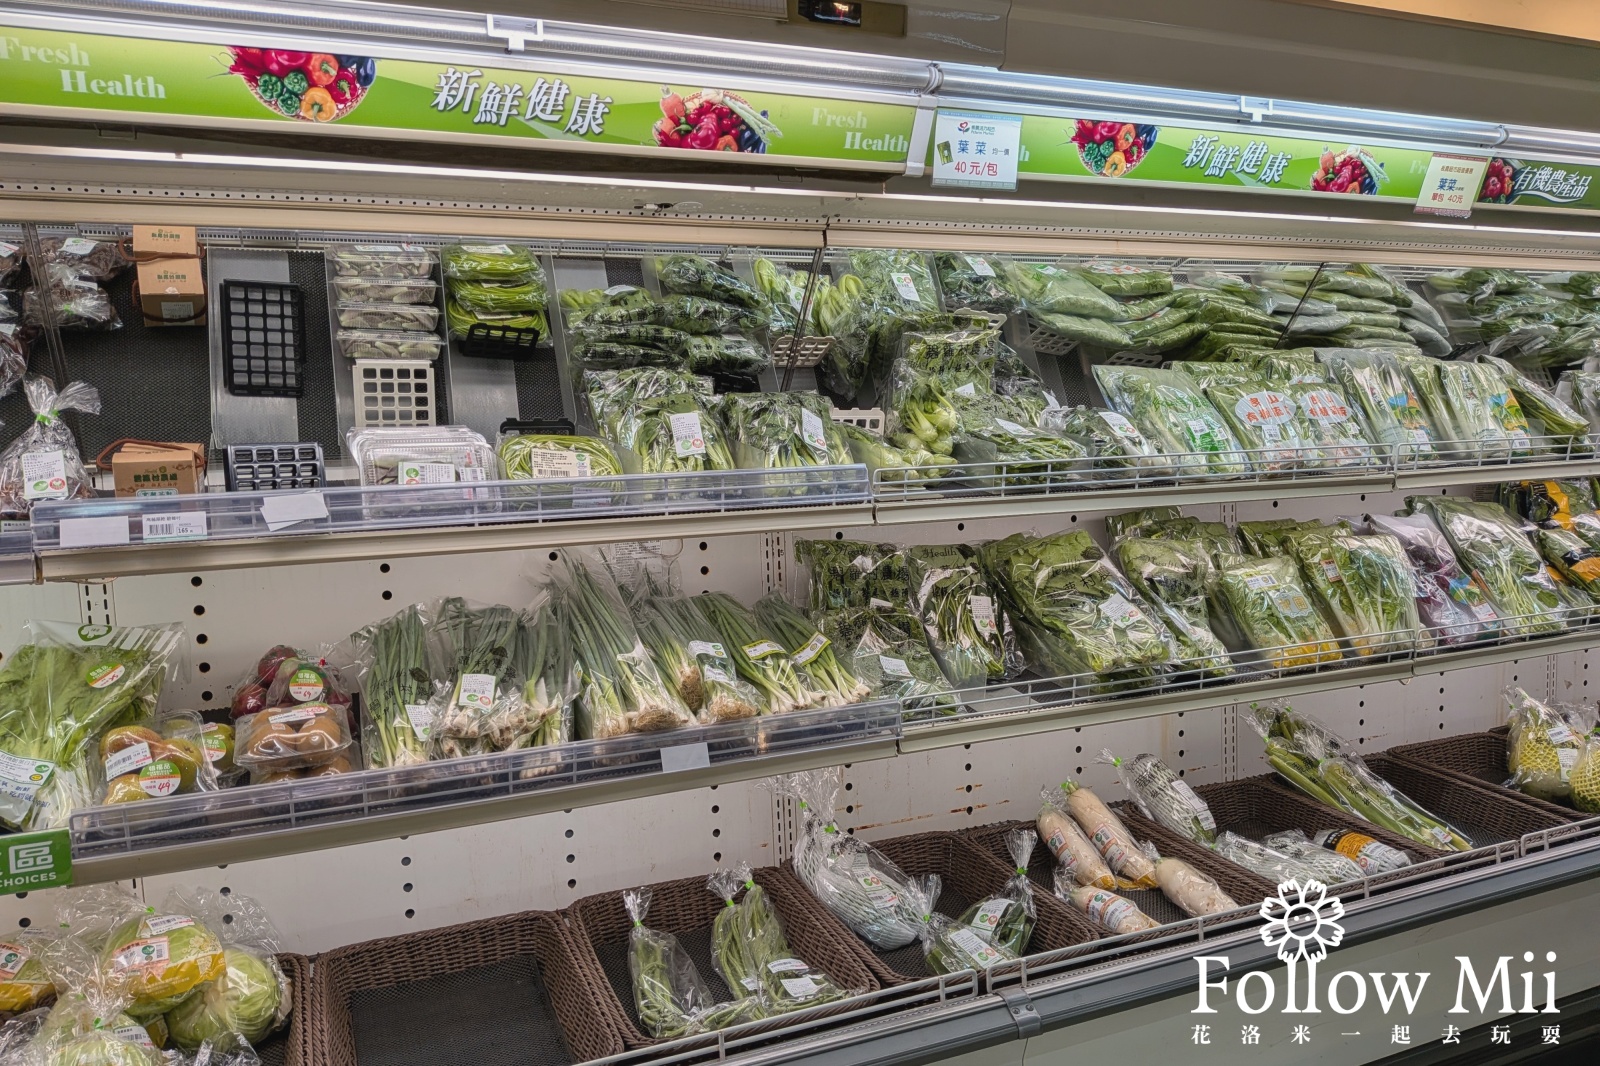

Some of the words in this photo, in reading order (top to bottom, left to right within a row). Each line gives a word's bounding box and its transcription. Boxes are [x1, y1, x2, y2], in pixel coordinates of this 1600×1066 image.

[0, 36, 90, 66] Fresh
[59, 69, 167, 99] Health
[431, 67, 612, 135] 新鮮健康
[811, 107, 868, 129] Fresh
[843, 131, 908, 153] Health
[957, 140, 987, 155] 葉菜
[954, 161, 967, 173] 40
[1182, 134, 1292, 183] 新鮮健康
[1436, 178, 1457, 191] 葉菜
[1514, 165, 1592, 199] 有機農產品
[158, 781, 171, 793] 49
[0, 840, 54, 875] 區
